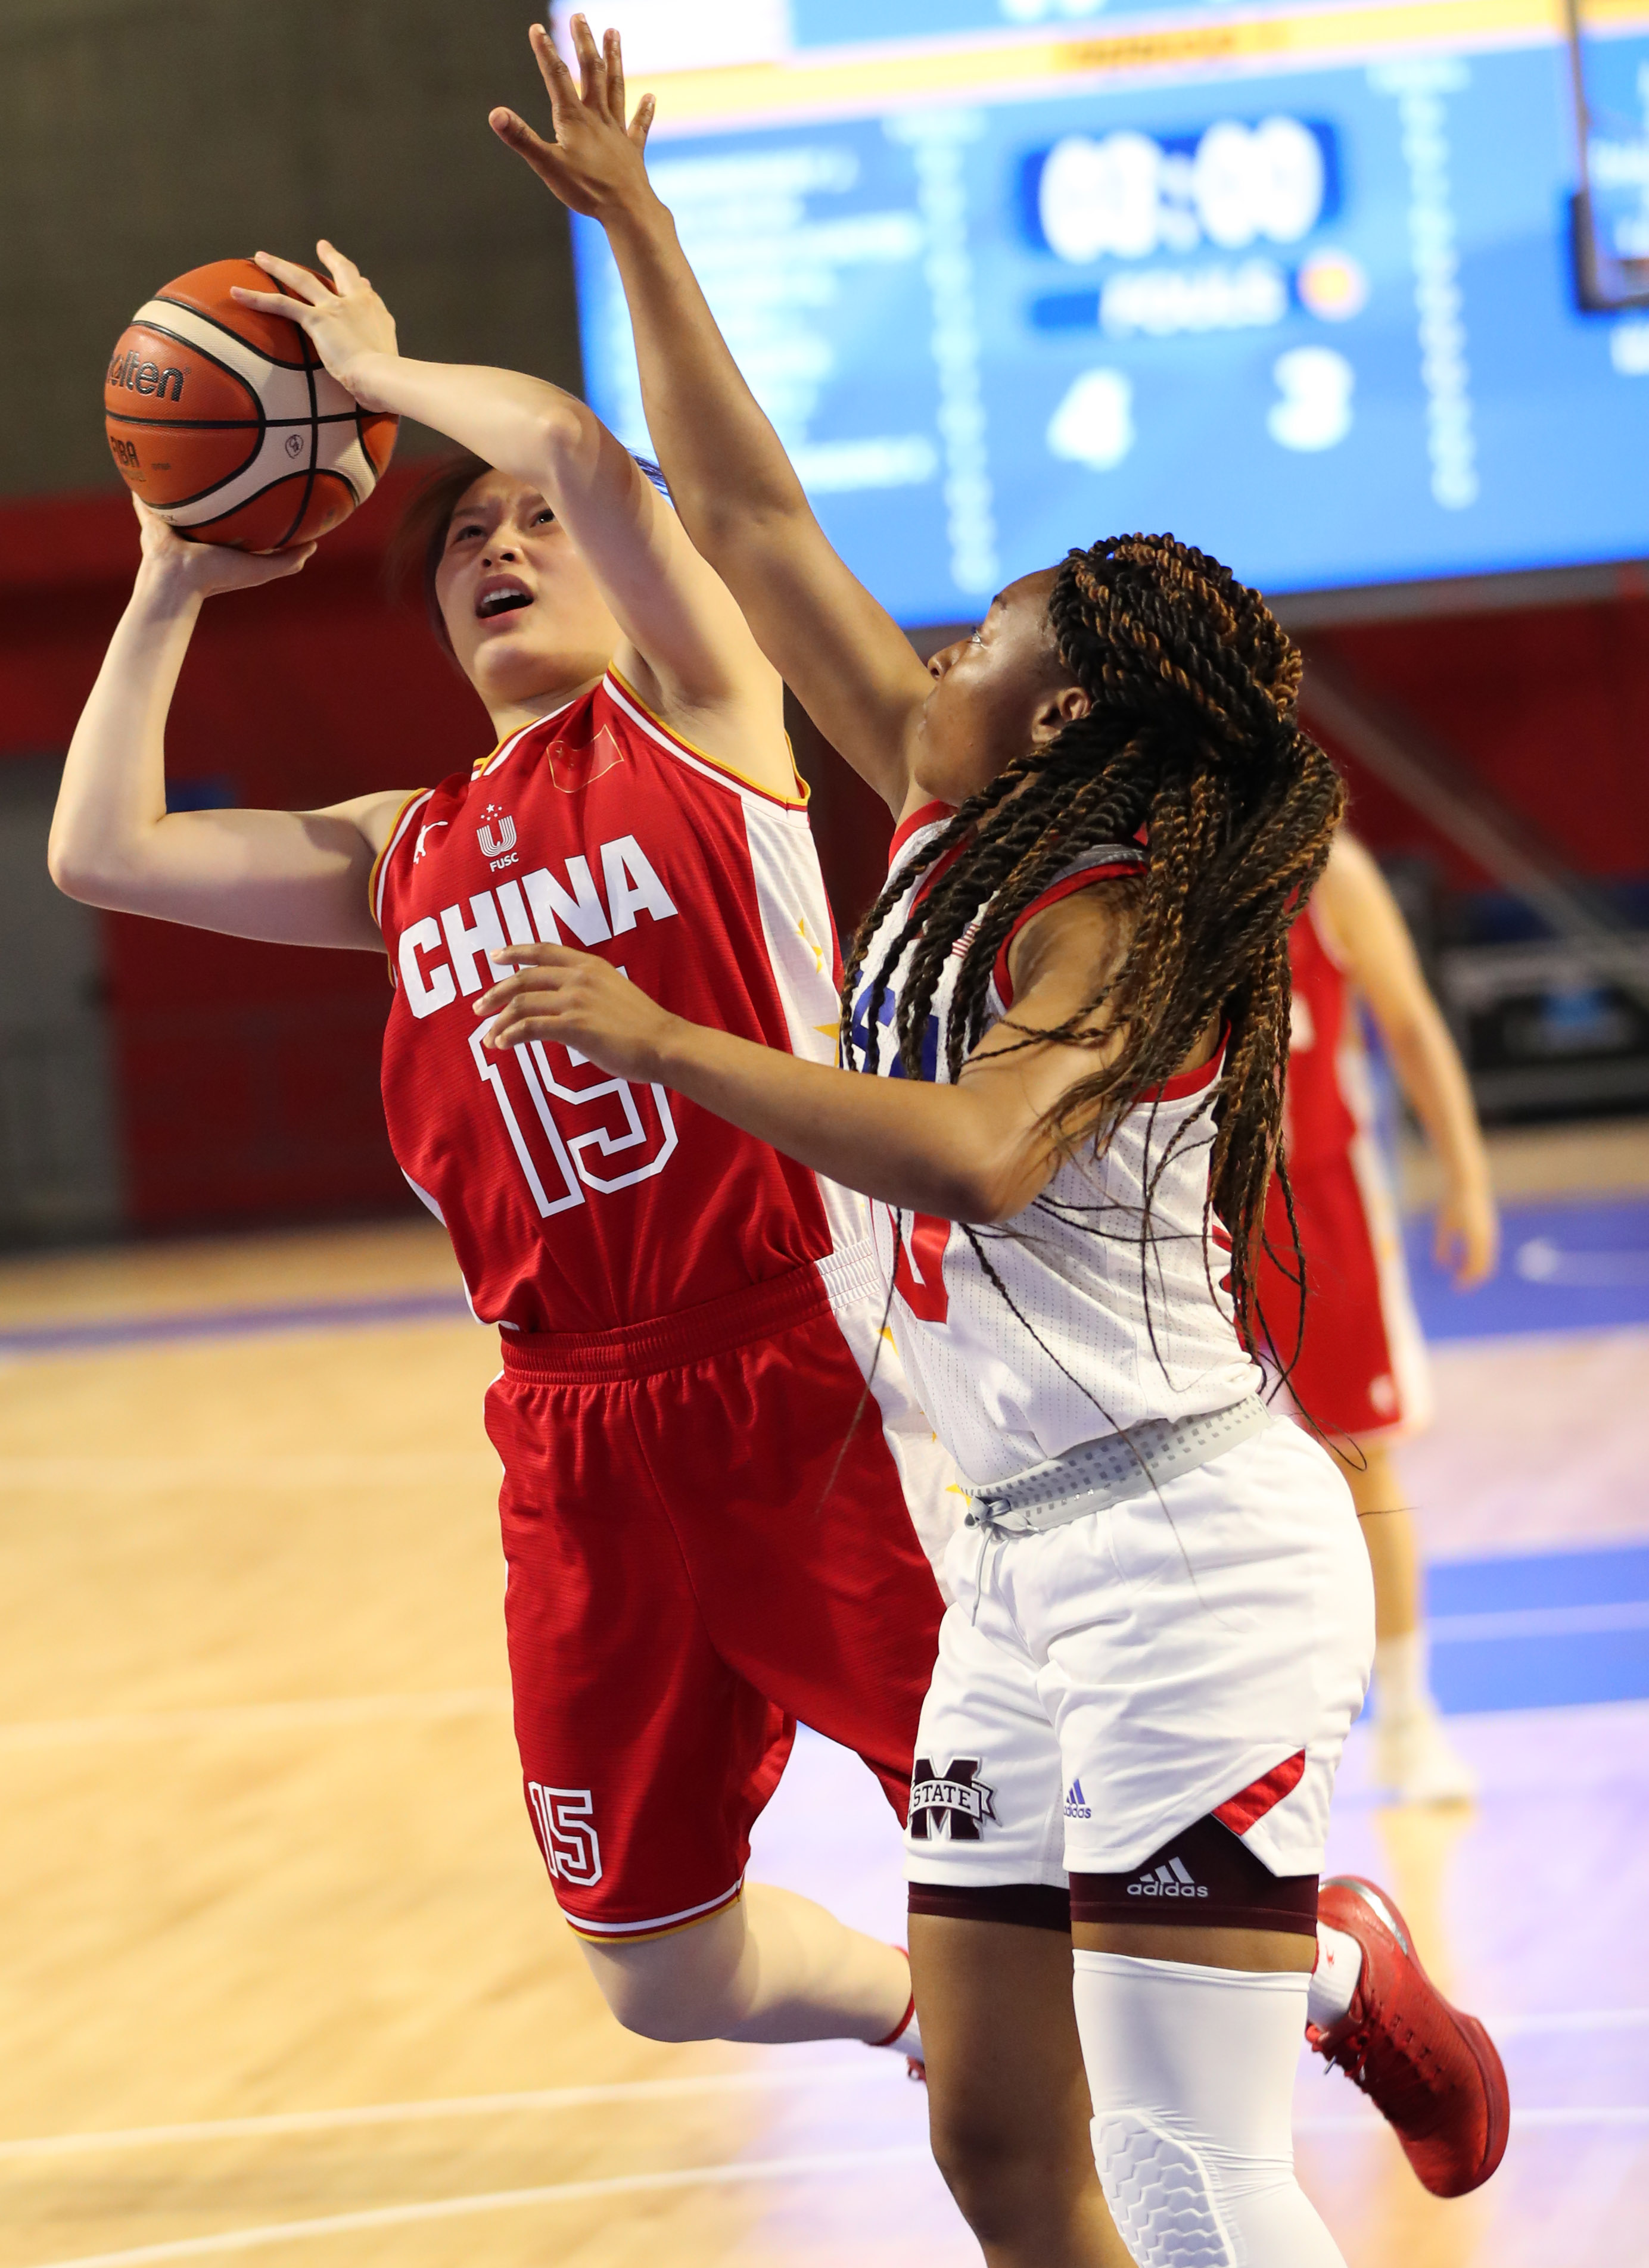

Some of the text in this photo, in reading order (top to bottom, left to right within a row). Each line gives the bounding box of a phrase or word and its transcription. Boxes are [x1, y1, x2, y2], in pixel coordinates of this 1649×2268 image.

[108, 350, 183, 401] olten
[1047, 367, 1135, 471] 4
[1267, 345, 1354, 452] 3
[490, 852, 519, 873] FUSC
[398, 834, 678, 1019] CHINA
[468, 966, 679, 1219] 15
[528, 1781, 603, 1887] 15
[913, 1784, 971, 1812] STATE
[1127, 1880, 1208, 1898] adidas
